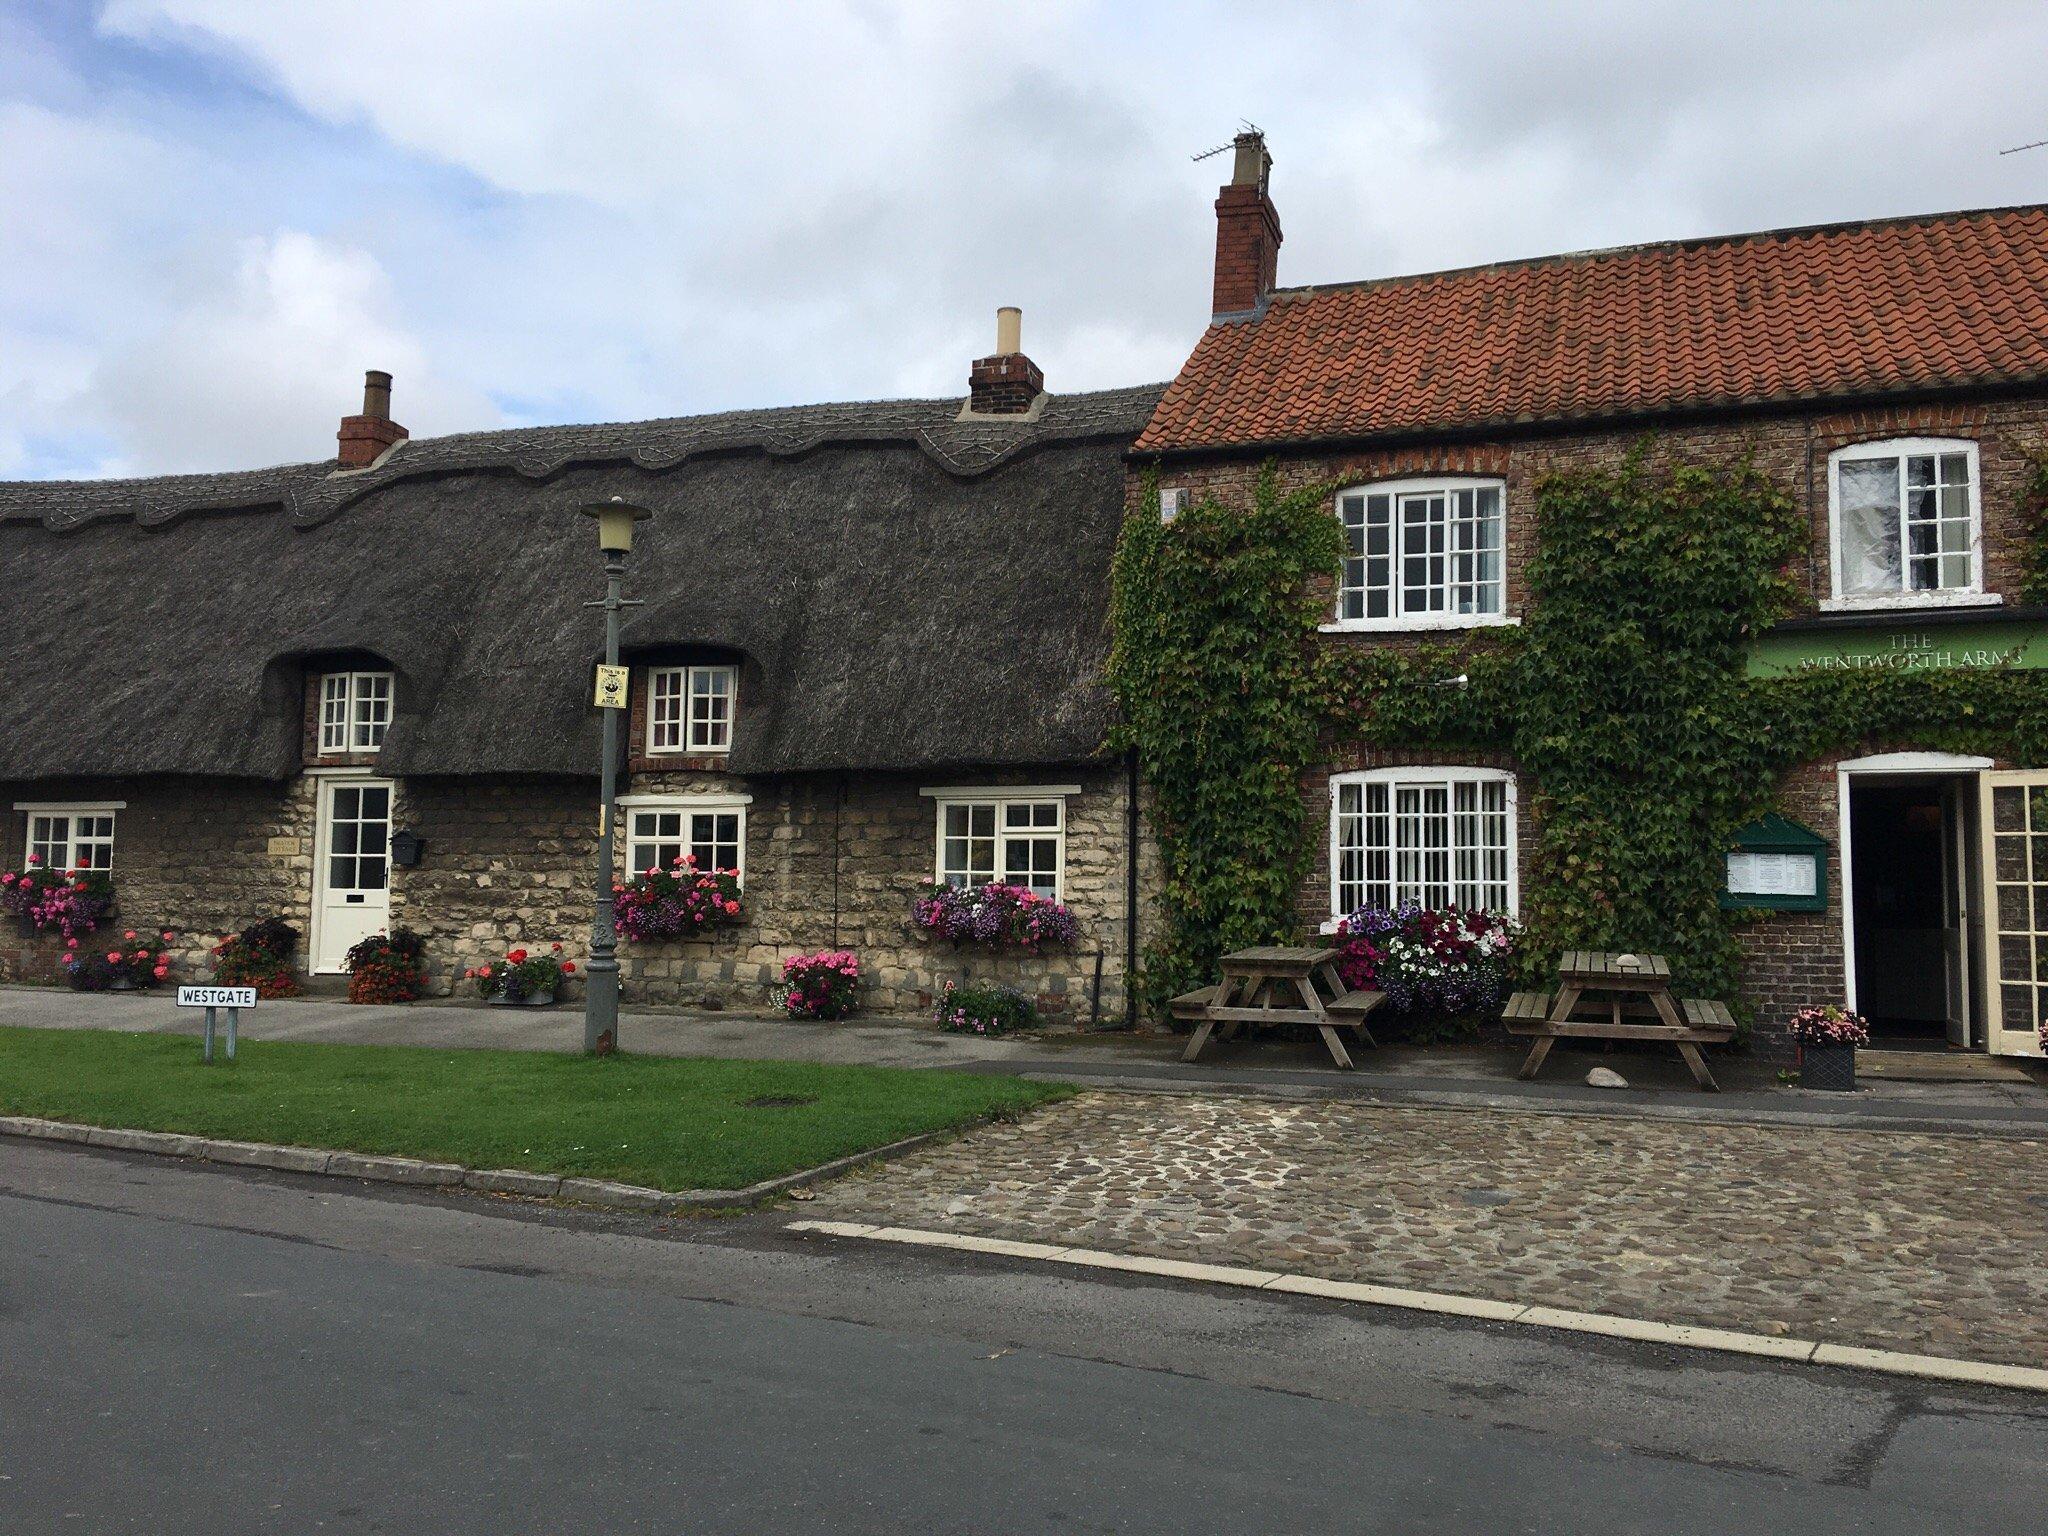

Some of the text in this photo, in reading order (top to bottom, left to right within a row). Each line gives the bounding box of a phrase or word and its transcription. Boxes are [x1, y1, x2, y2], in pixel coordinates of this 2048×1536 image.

[1887, 634, 1932, 649] THE
[1801, 650, 2023, 669] WENTWORTH ARMS
[183, 990, 251, 1003] WESTGATE
